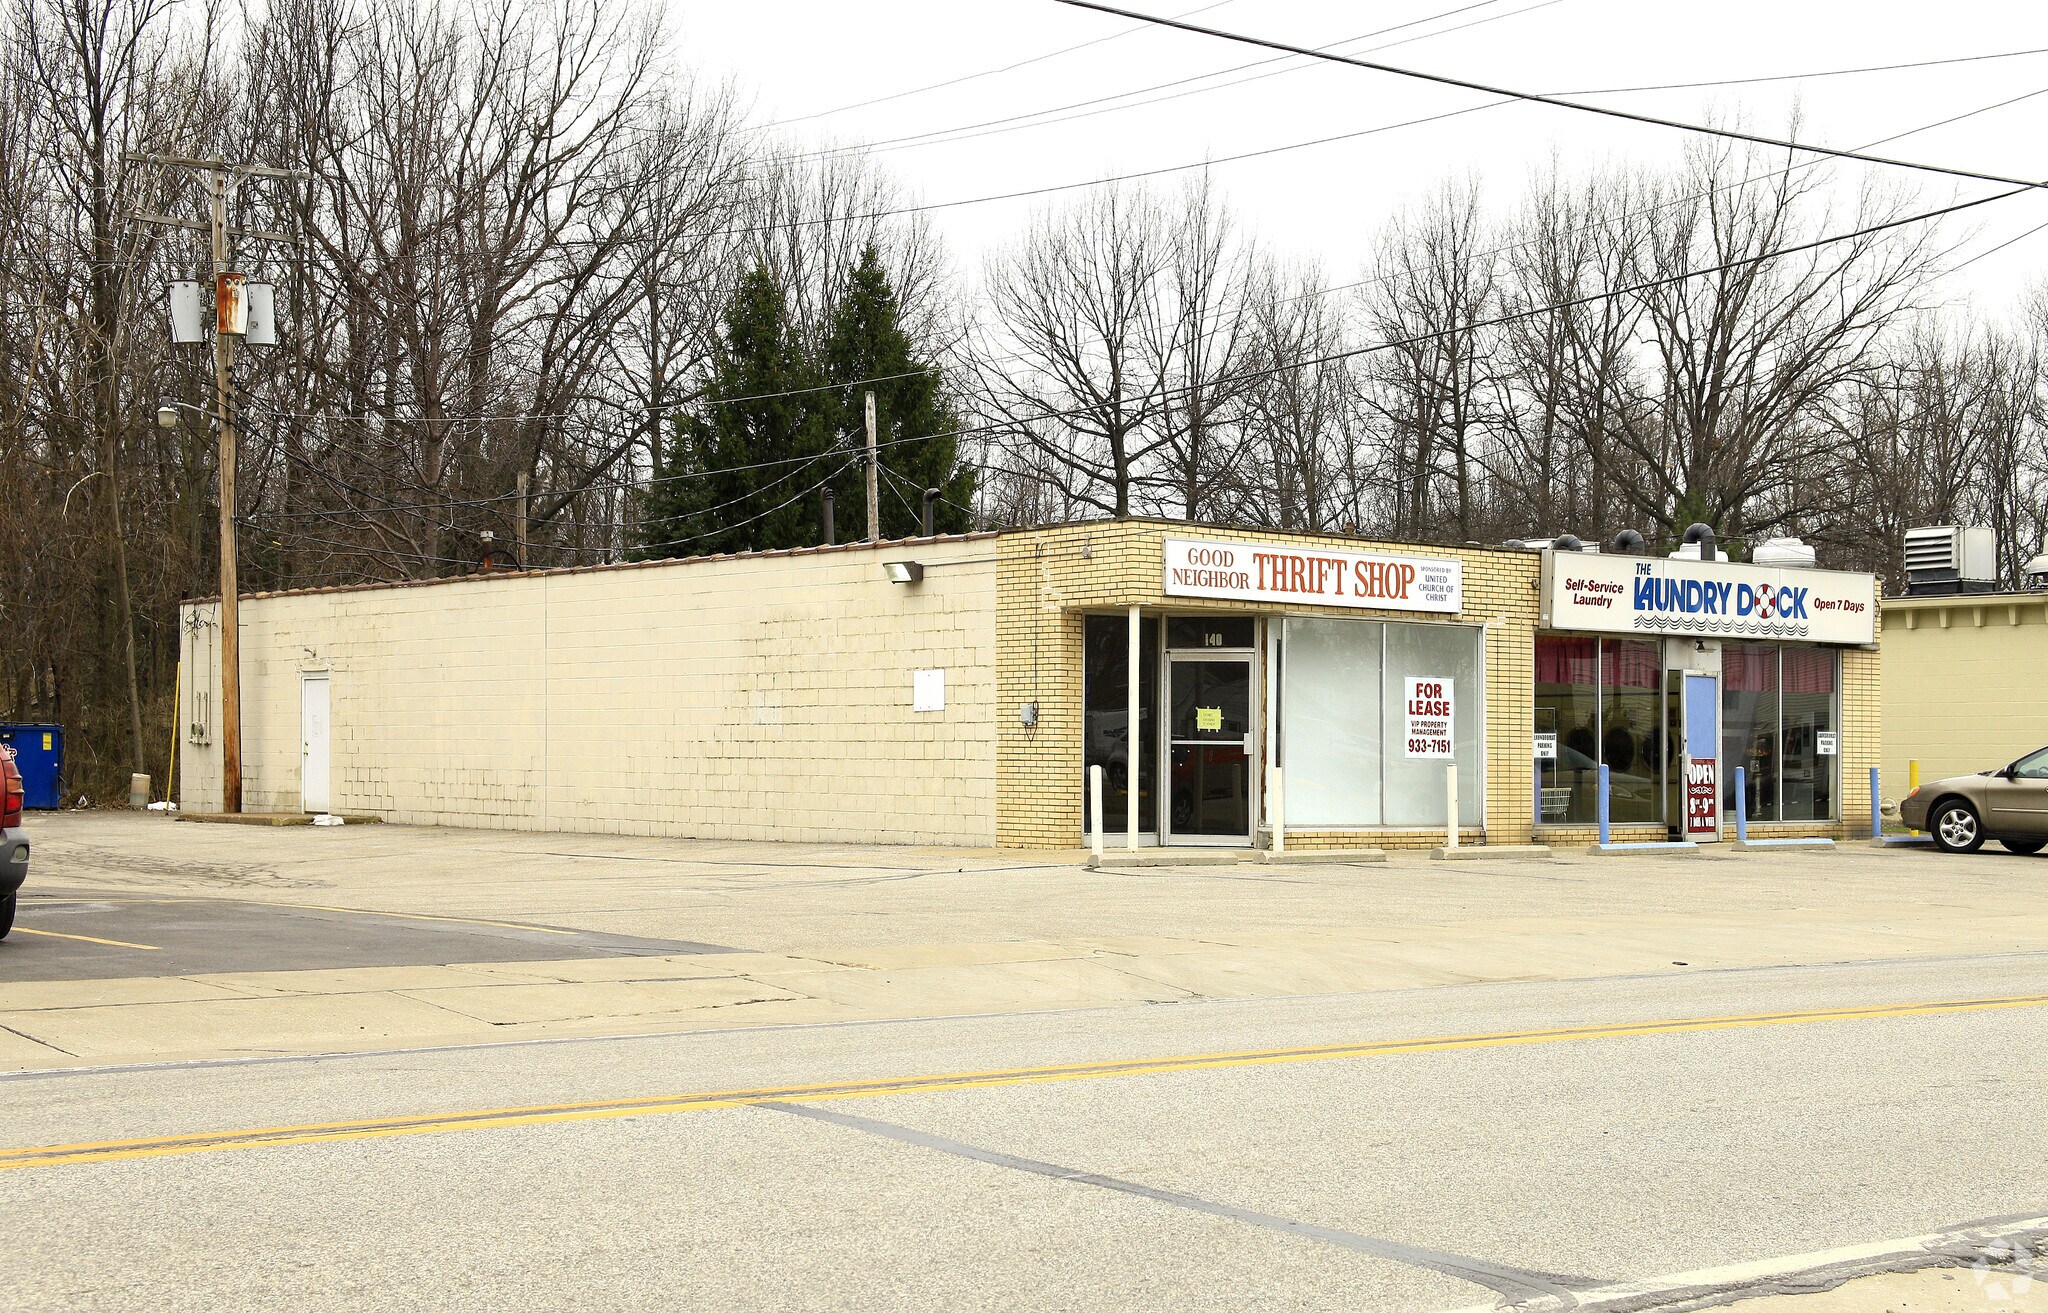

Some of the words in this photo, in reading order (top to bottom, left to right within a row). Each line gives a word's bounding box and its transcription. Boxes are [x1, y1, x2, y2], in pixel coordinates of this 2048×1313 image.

[1188, 548, 1234, 567] GOOD
[1253, 553, 1347, 595] THRIFT
[1354, 560, 1415, 600] SHOP
[1635, 562, 1652, 576] THE
[1172, 568, 1250, 590] NEIGHBOR
[1425, 575, 1448, 584] UNITED
[1565, 577, 1624, 594] Self-Service
[1418, 583, 1444, 593] CHURCH
[1446, 585, 1454, 593] OF
[1425, 593, 1447, 602] CHRIST
[1573, 593, 1613, 609] Laundry
[1633, 576, 1733, 615] LAUNDRY
[1736, 583, 1809, 620] DOCK
[1814, 597, 1836, 611] Open
[1837, 599, 1843, 610] 7
[1843, 599, 1865, 613] Days
[1205, 633, 1223, 646] 140
[1416, 682, 1442, 699] FOR
[1408, 699, 1450, 717] LEASE
[1411, 720, 1420, 728] VIP
[1420, 720, 1447, 729] PROPERTY
[1411, 728, 1447, 737] MANAGEMENT
[1408, 738, 1450, 753] 933-7151
[1689, 764, 1715, 785] OPEN
